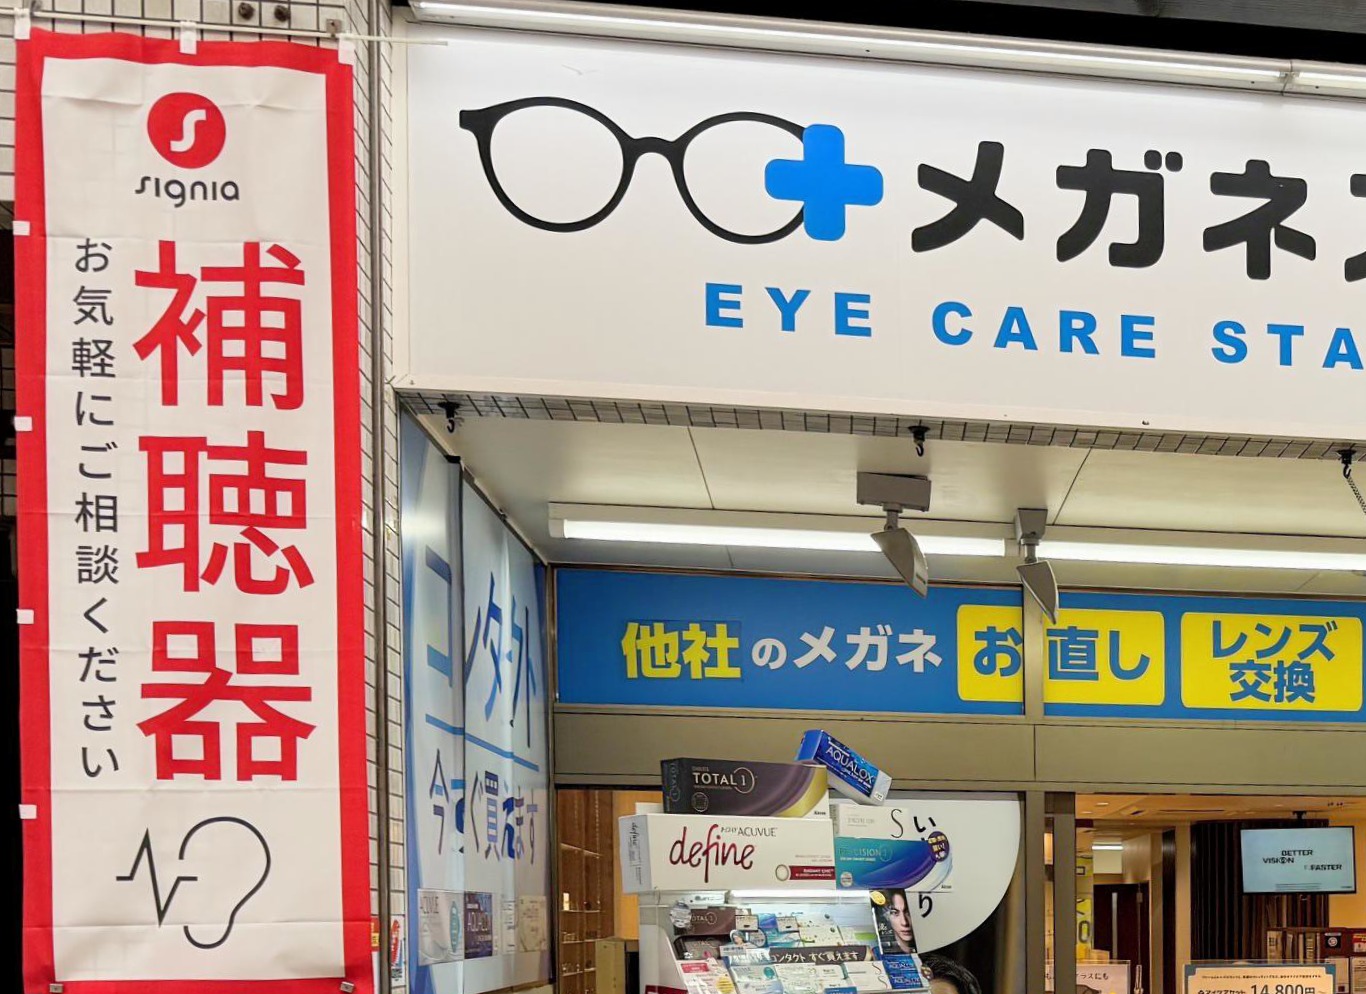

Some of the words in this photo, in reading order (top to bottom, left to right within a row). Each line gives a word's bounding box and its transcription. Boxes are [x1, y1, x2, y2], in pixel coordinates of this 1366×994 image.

[135, 175, 240, 207] signia
[704, 282, 873, 338] EYE
[931, 301, 1158, 359] CARE
[71, 236, 119, 778] お気軽にご相談ください
[132, 239, 316, 781] 補聴器
[621, 622, 942, 680] 他社のメガネ
[973, 625, 1150, 681] お直し
[1211, 620, 1337, 661] レンズ
[1228, 658, 1316, 705] 交換
[692, 772, 737, 786] TOTAL
[825, 746, 873, 785] AQUALOX
[669, 824, 755, 883] define
[737, 827, 777, 837] ACUVUE
